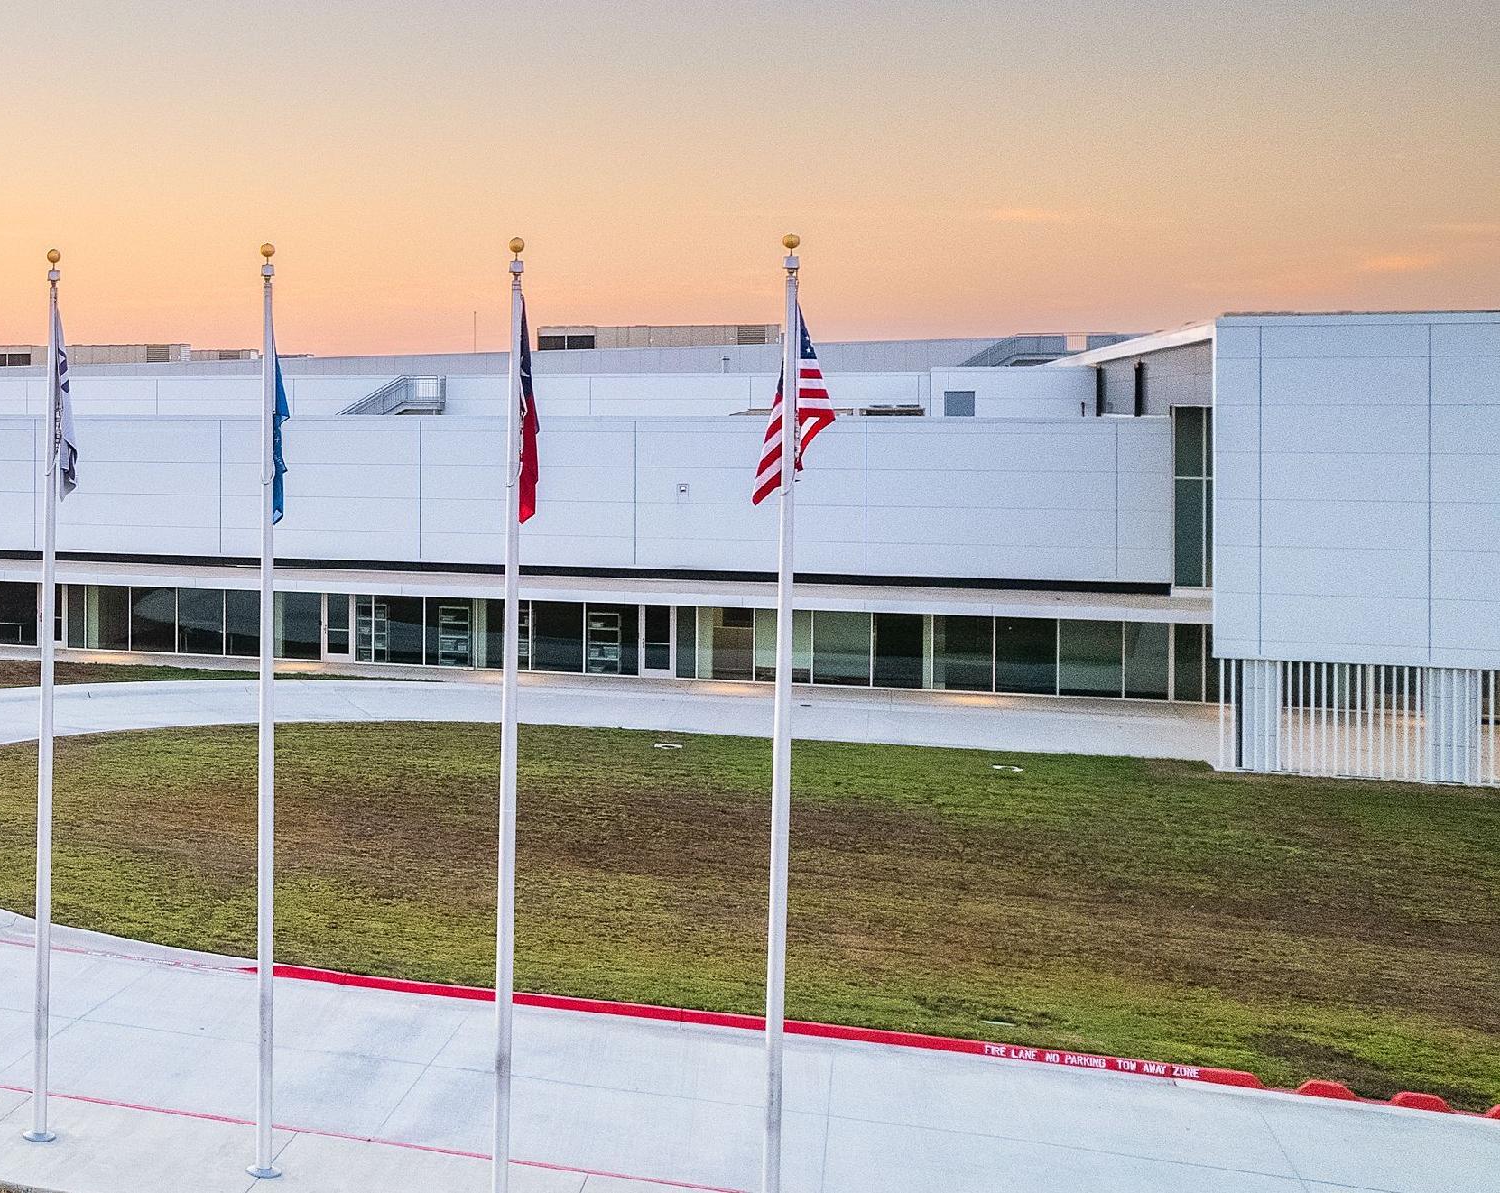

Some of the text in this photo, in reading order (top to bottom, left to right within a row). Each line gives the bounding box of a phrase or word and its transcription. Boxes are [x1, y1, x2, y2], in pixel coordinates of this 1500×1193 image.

[984, 1044, 1200, 1078] FIRE LANE NO PARKING TOW AWAY ZONE
